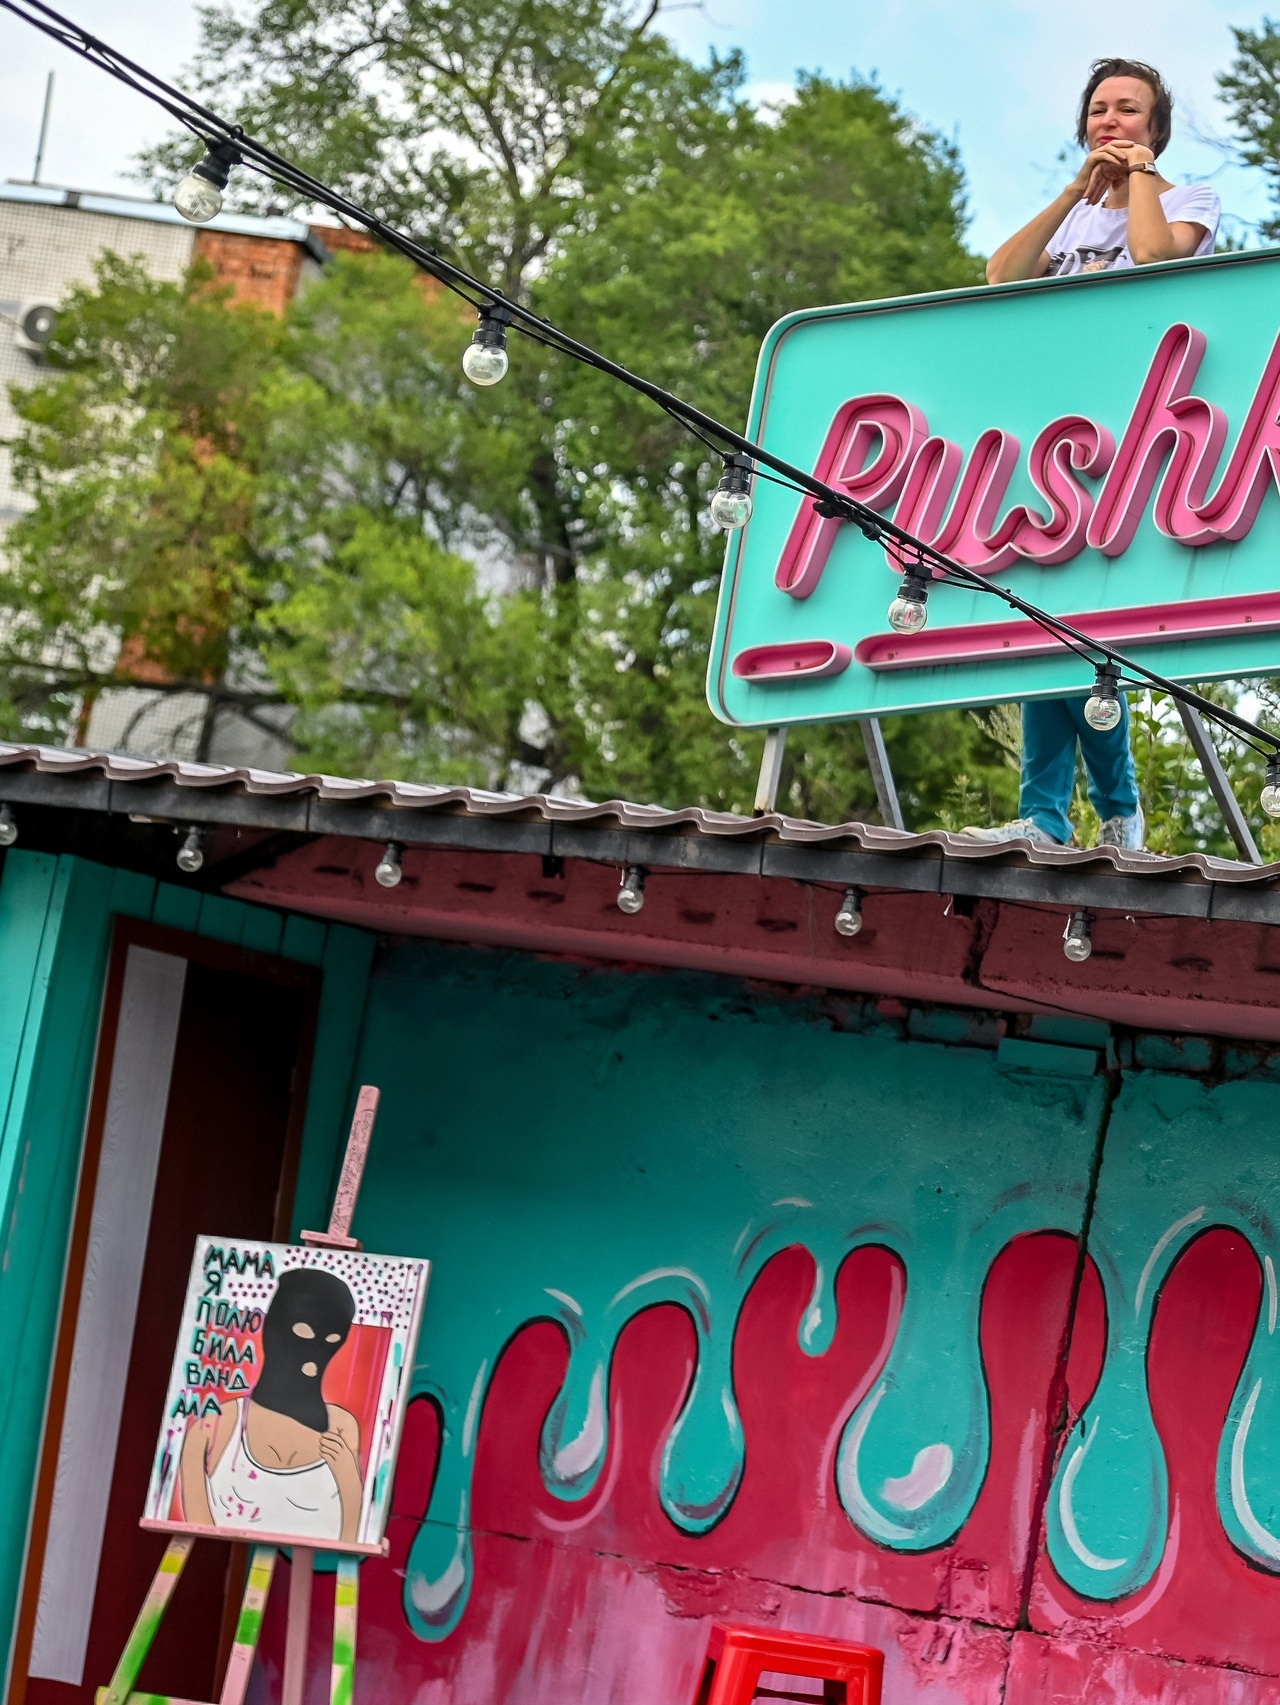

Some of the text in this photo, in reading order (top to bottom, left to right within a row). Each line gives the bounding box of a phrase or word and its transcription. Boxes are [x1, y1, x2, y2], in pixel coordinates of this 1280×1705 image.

[205, 1245, 275, 1279] МАМА
[204, 1271, 222, 1296] Я
[195, 1298, 263, 1334] ПОЛЮ
[191, 1329, 255, 1364] БИЛА
[186, 1363, 250, 1390] ВАНД
[171, 1396, 222, 1420] АЛА
